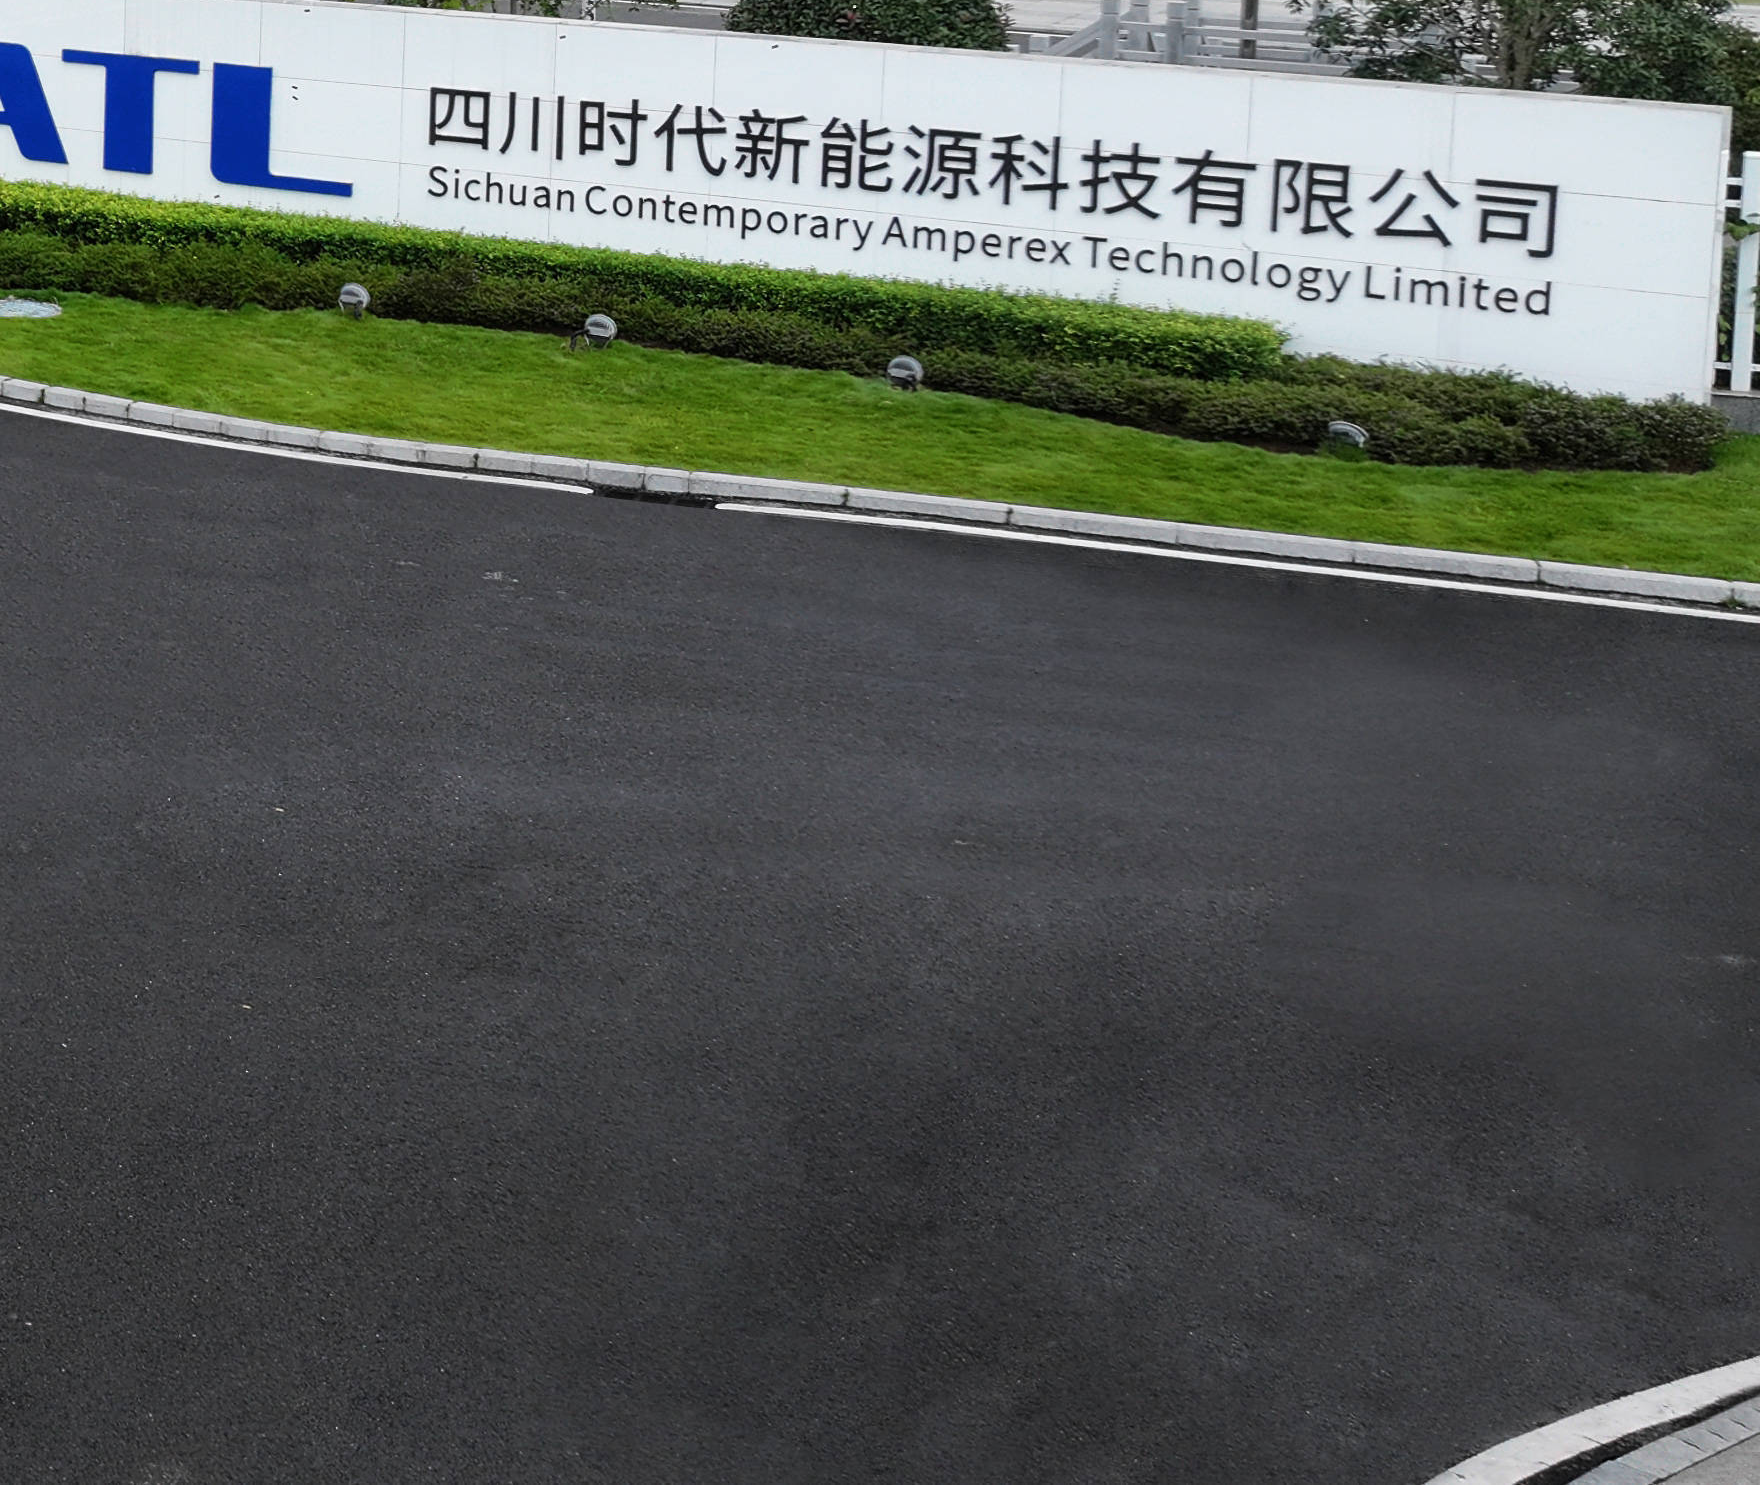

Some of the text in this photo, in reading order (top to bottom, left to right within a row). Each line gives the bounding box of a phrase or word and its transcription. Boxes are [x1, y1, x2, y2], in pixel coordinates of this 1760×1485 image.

[426, 165, 1553, 317] Sichuan Contemporary Amperex Technology Limited
[428, 86, 1558, 259] 四川时代新能源科技有限公司
